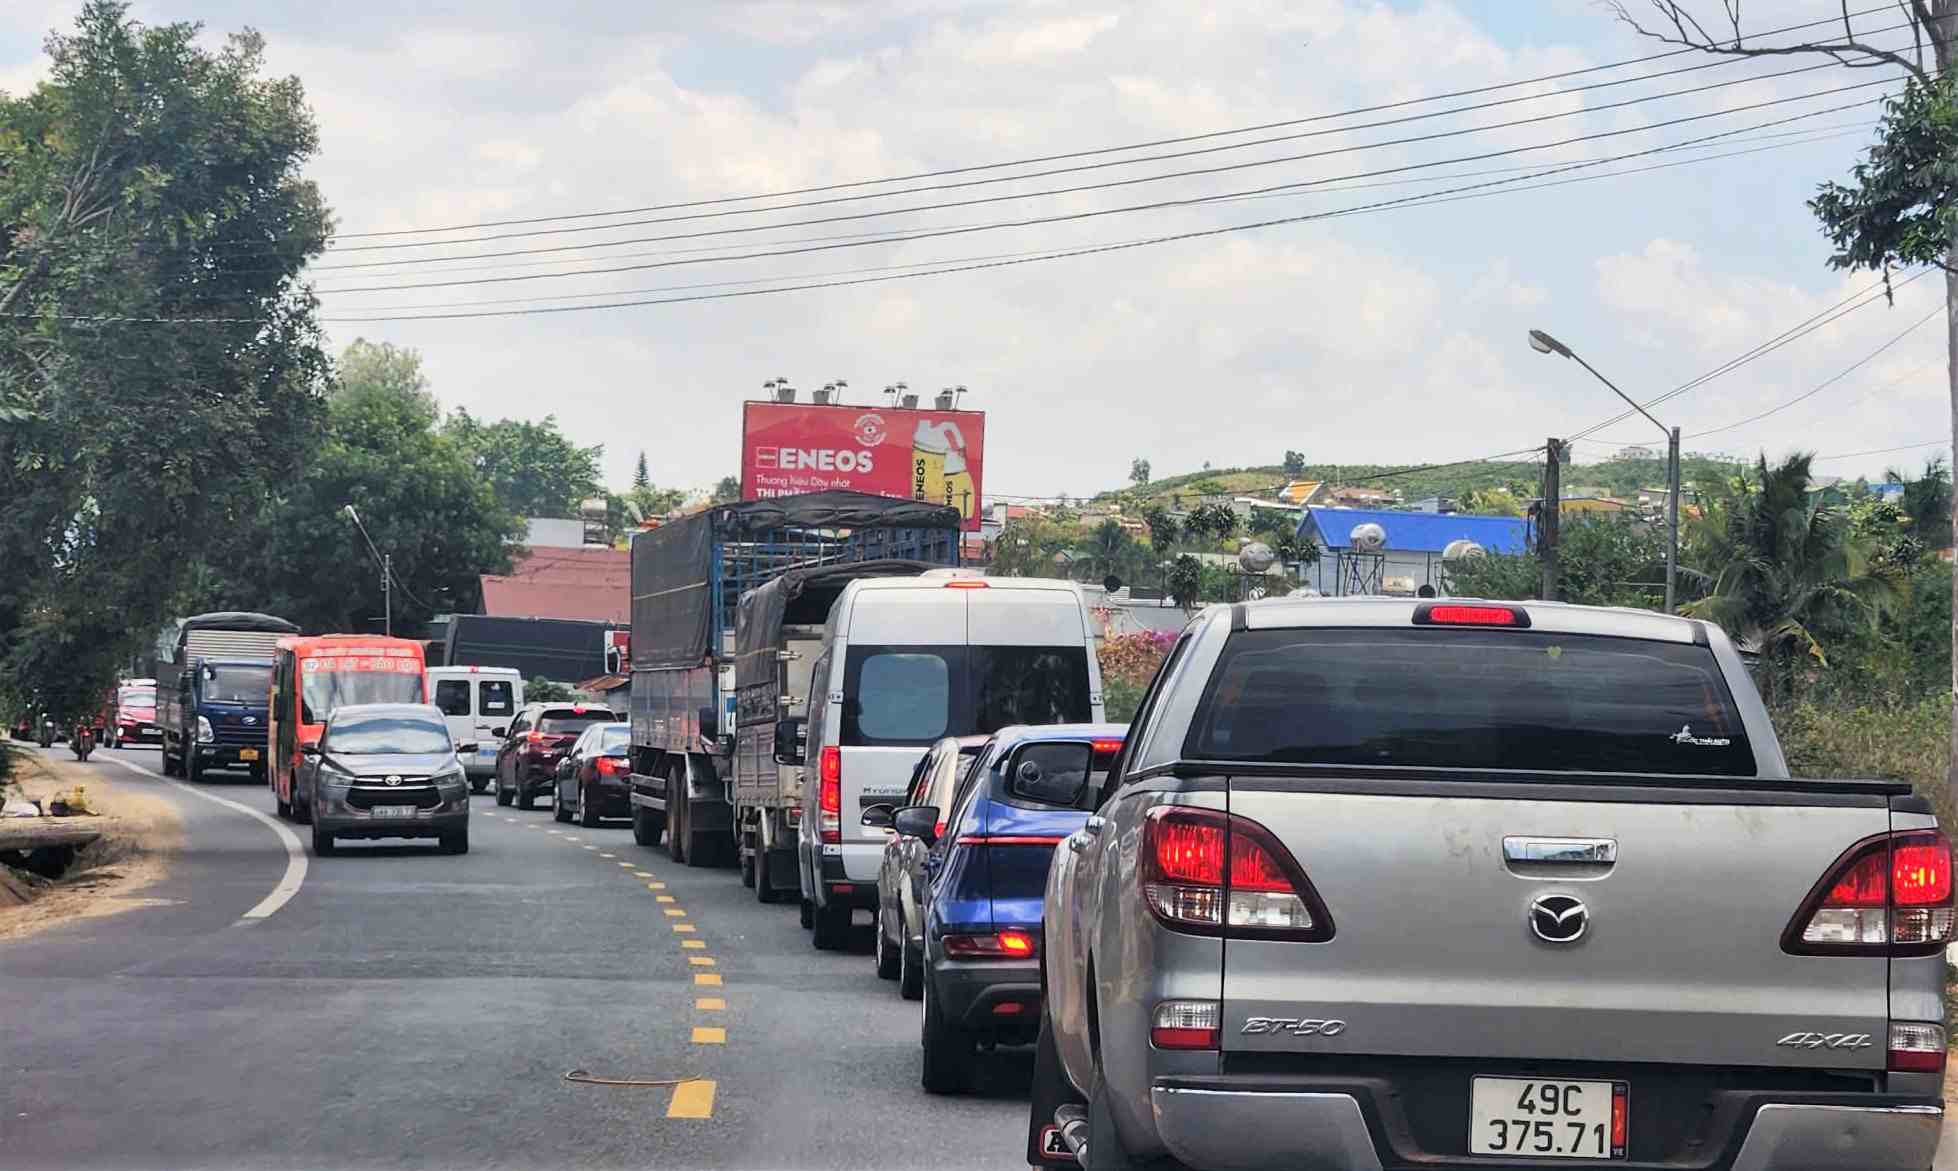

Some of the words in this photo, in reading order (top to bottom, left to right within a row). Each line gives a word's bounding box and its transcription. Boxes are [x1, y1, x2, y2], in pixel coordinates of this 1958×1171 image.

[780, 447, 873, 473] ENEOS
[916, 459, 926, 501] ENEOS
[1241, 1017, 1346, 1036] BT-50
[1518, 1083, 1582, 1116] 49C
[1488, 1119, 1605, 1154] 375.71
